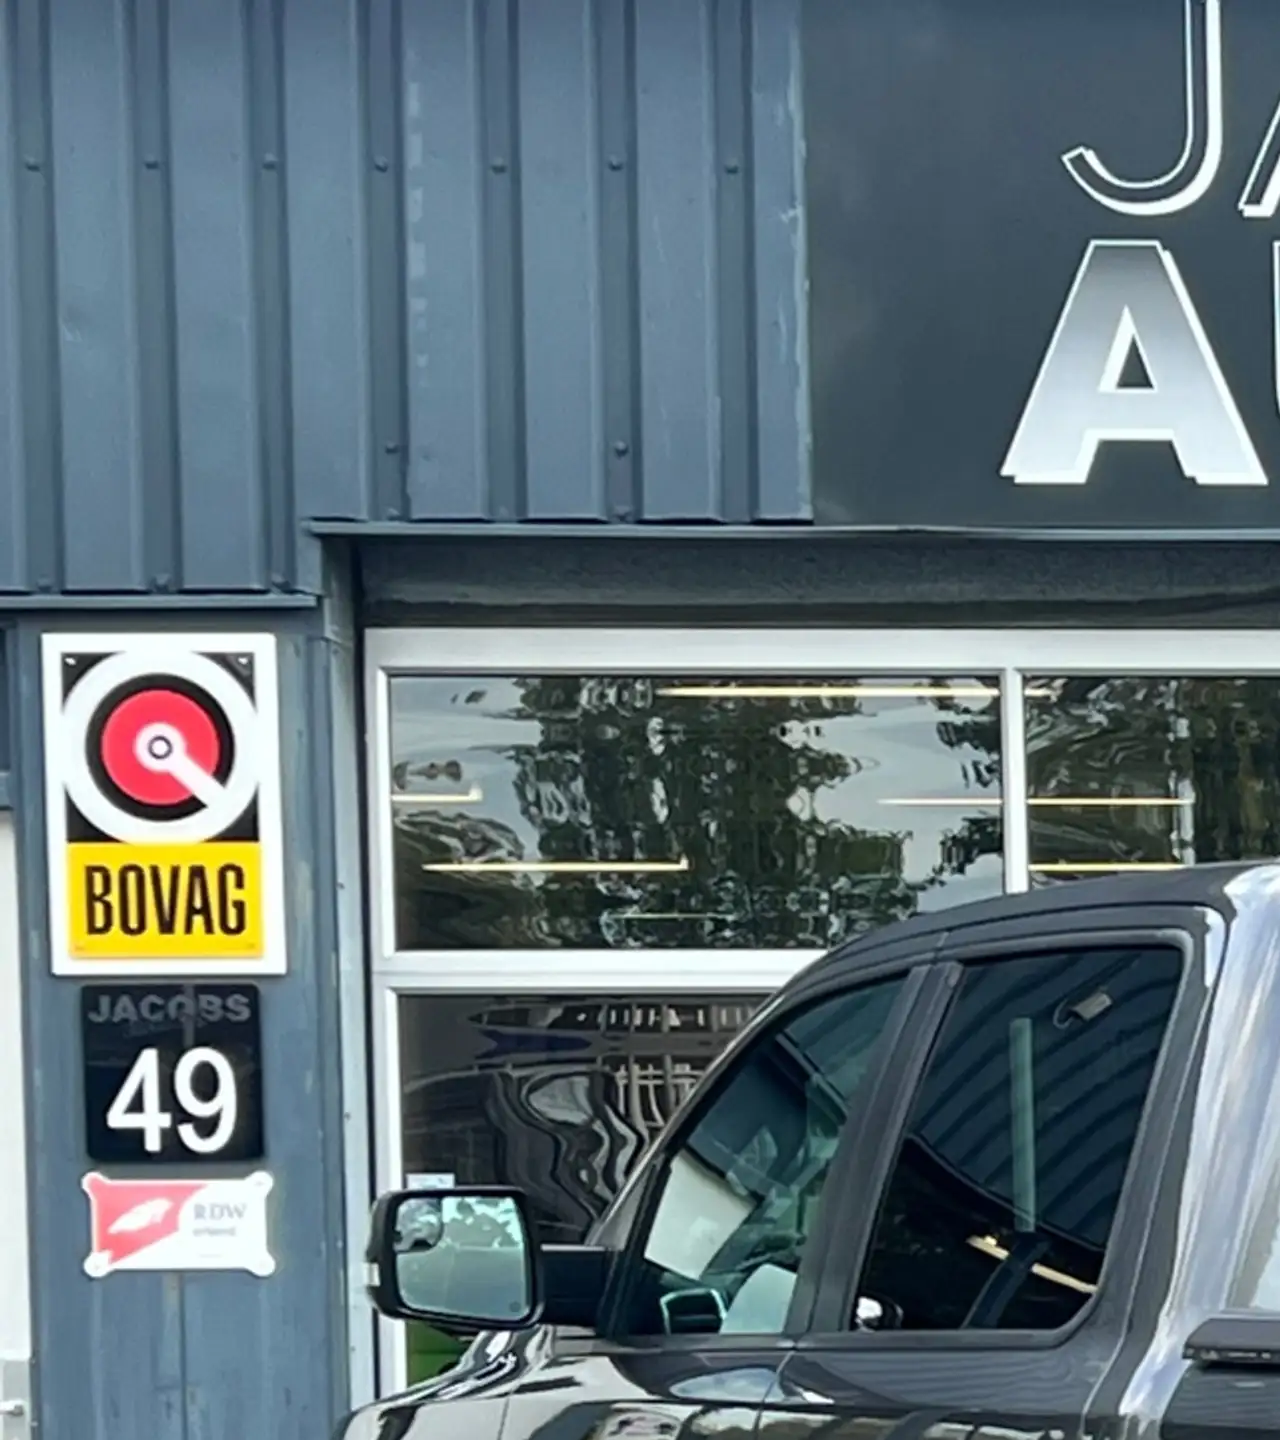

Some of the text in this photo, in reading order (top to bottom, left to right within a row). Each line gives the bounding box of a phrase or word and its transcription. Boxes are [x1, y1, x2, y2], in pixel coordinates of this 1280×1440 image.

[84, 863, 247, 937] BOVAG
[87, 993, 251, 1023] JACOBS
[106, 1046, 237, 1154] 49
[193, 1202, 247, 1220] RDW
